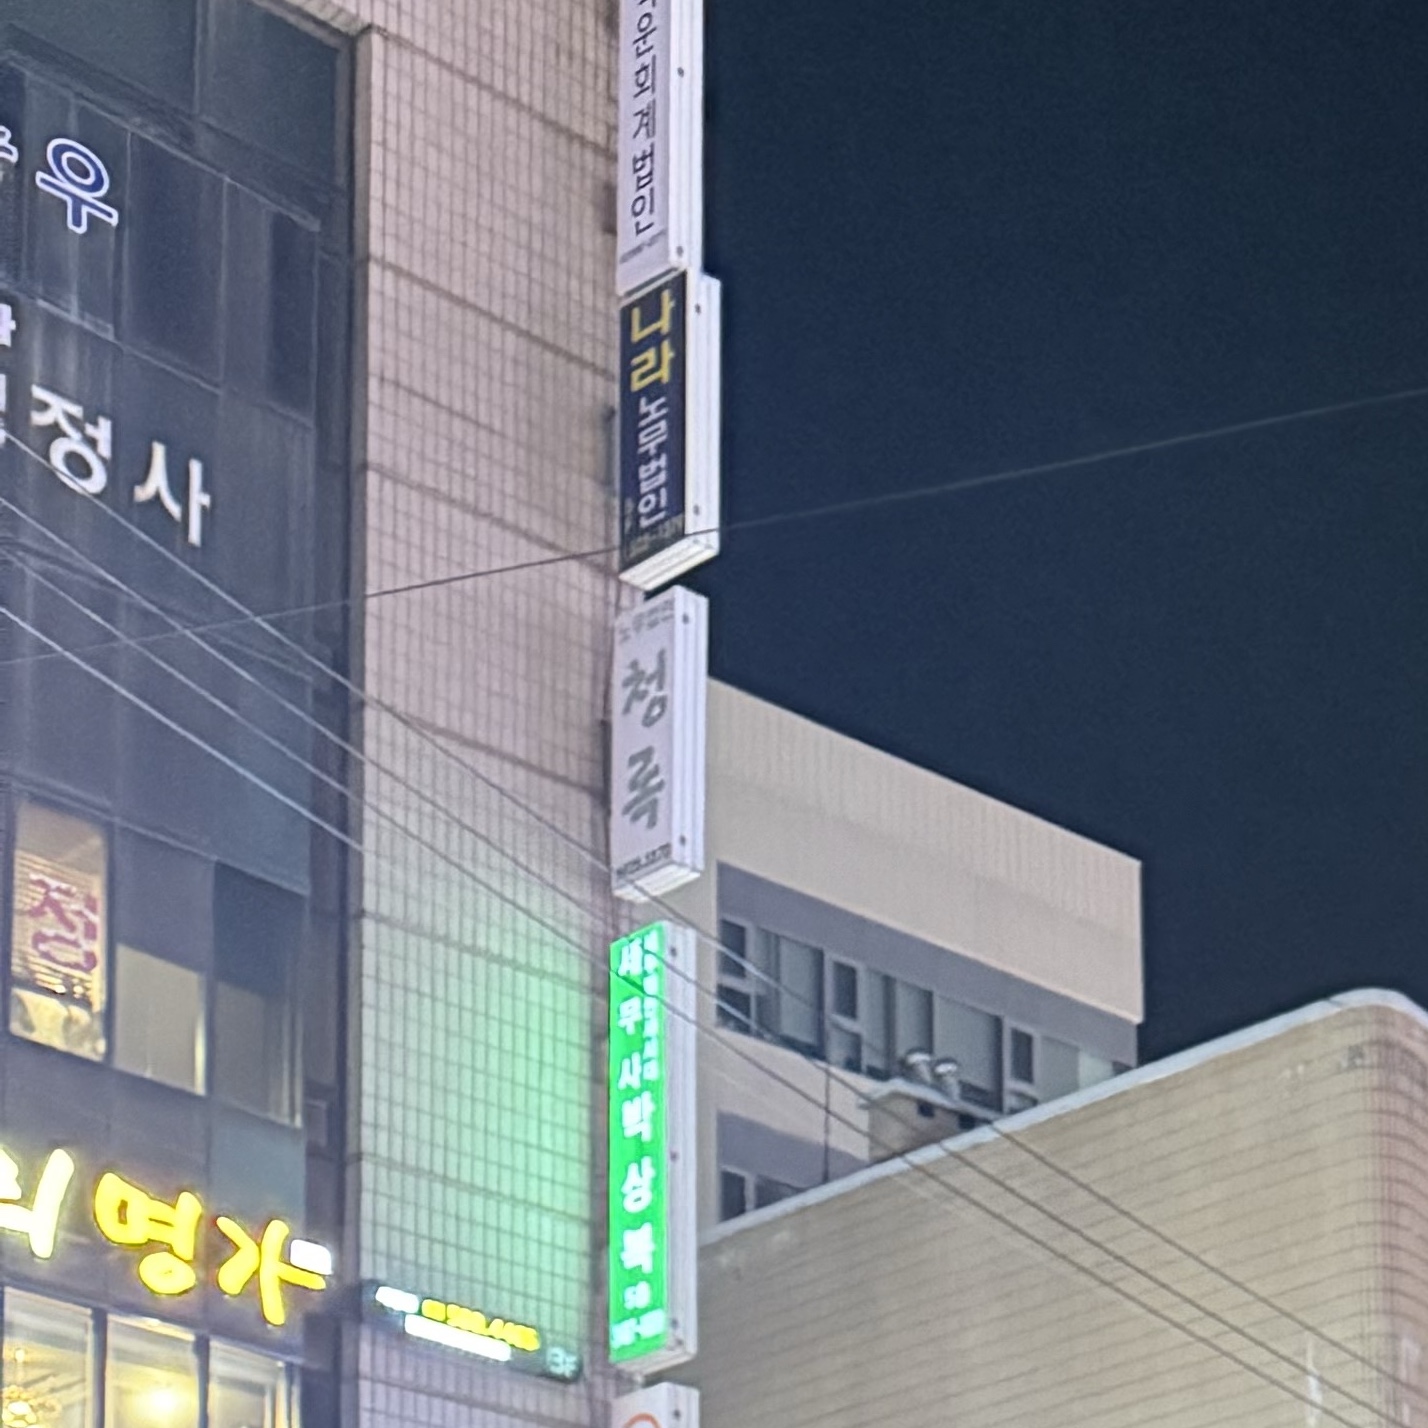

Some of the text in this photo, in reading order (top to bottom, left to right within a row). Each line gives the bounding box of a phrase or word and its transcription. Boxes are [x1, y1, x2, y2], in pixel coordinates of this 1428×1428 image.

[630, 287, 676, 393] 나라
[637, 396, 670, 529] 노무법인
[621, 649, 668, 830] 청록
[94, 1172, 327, 1326] 명가
